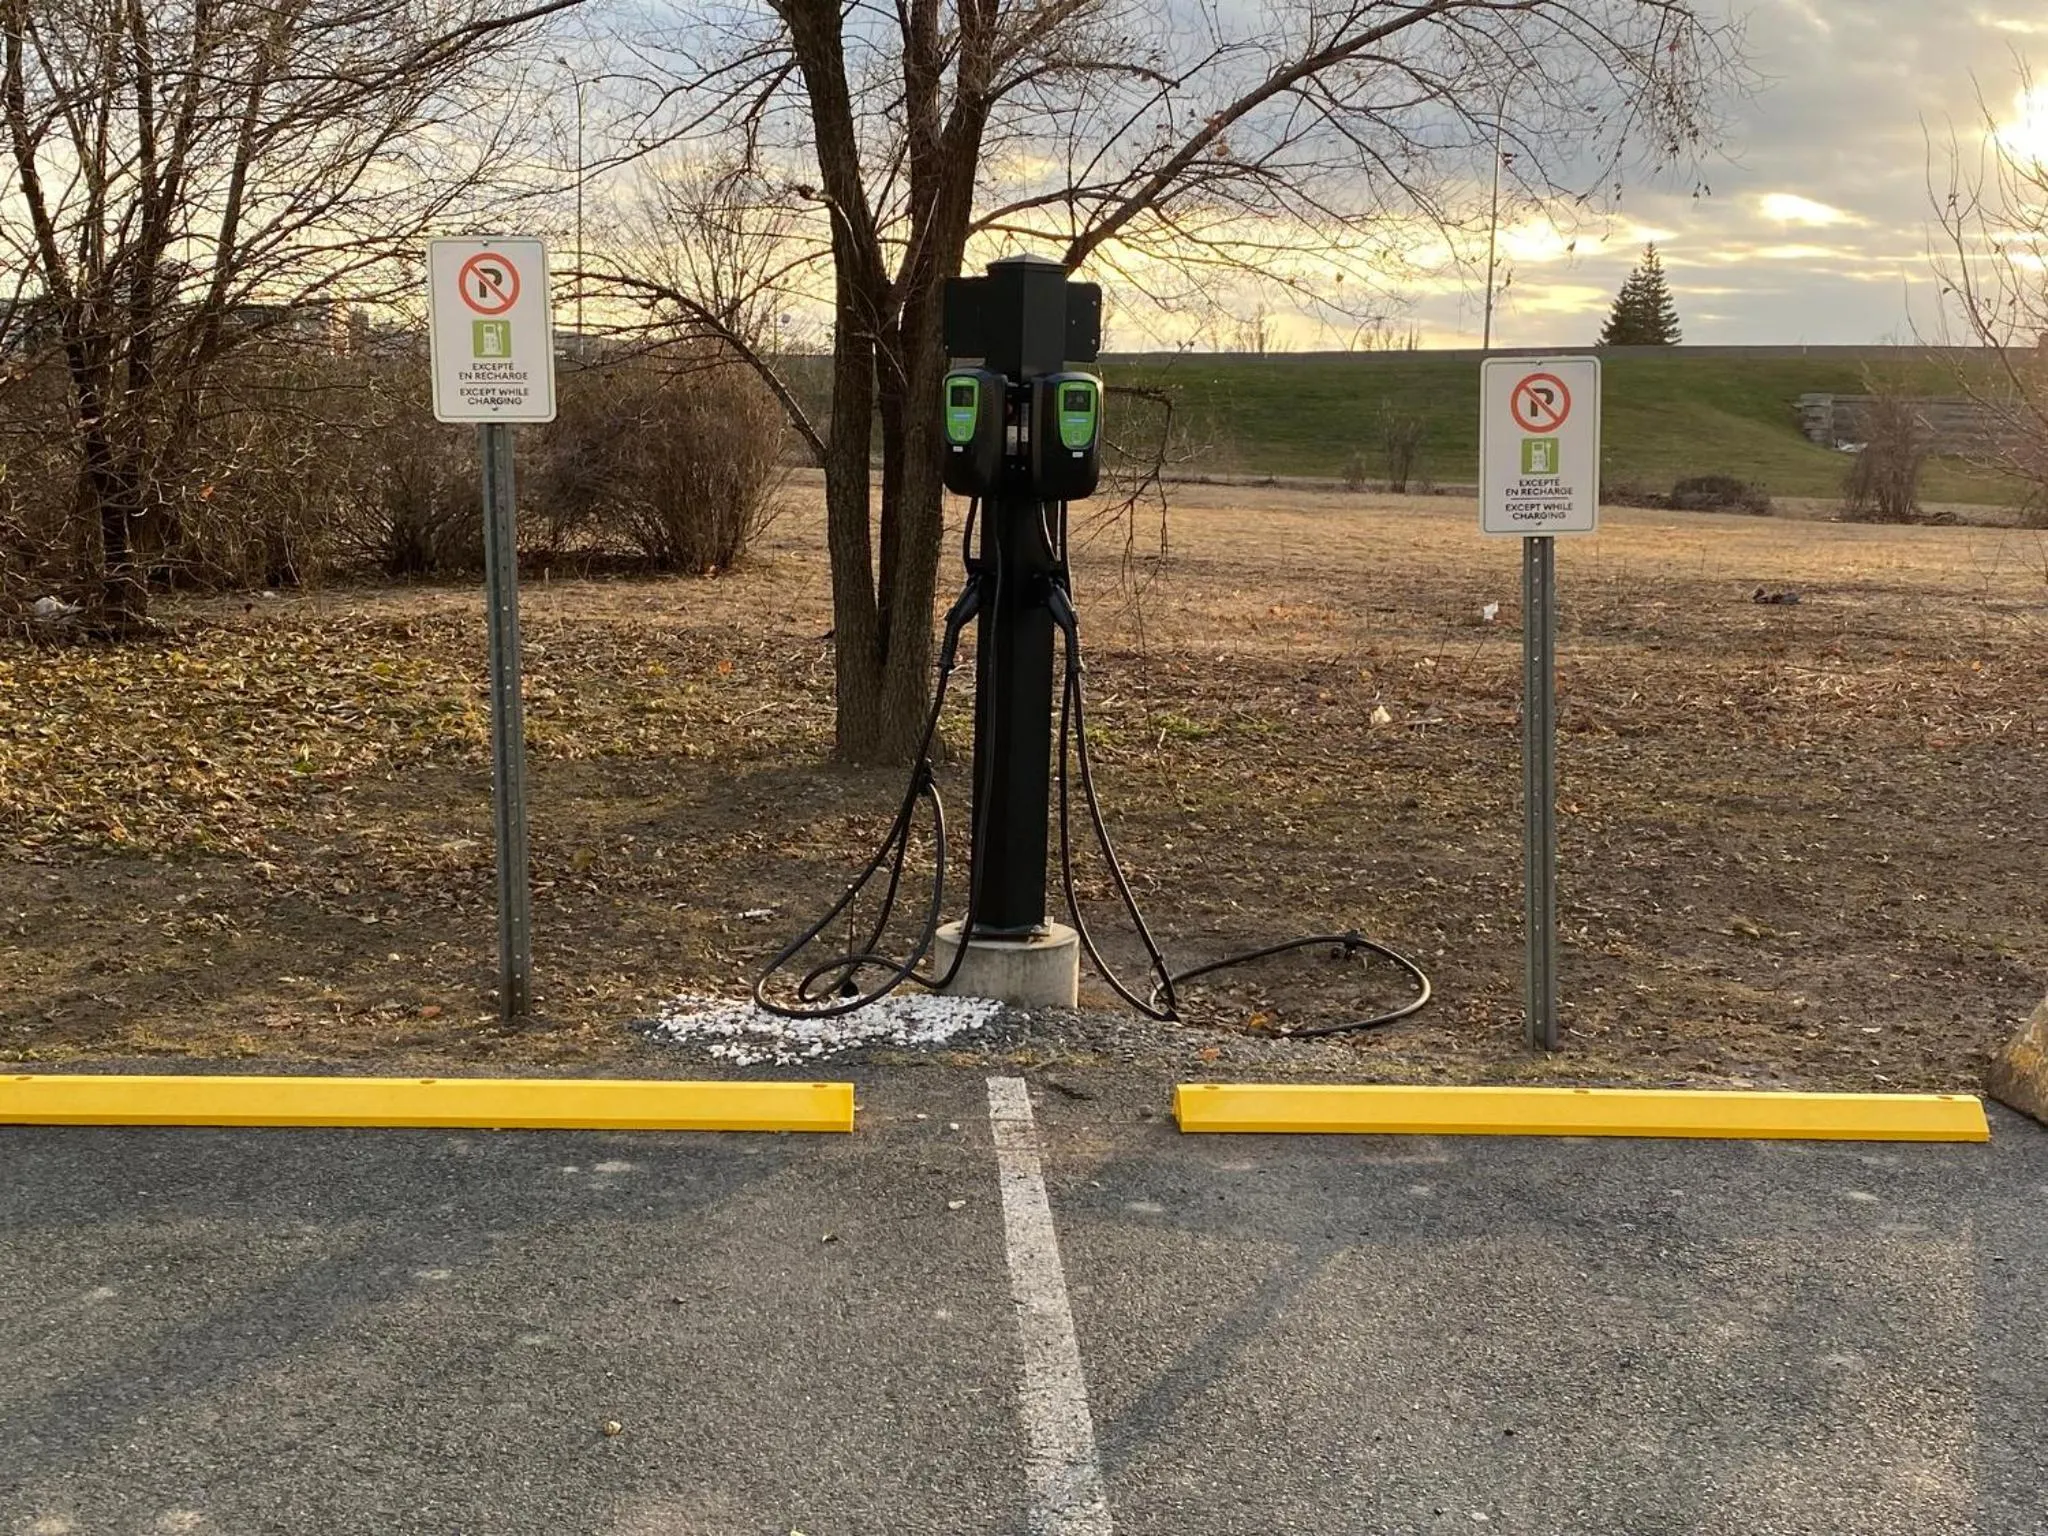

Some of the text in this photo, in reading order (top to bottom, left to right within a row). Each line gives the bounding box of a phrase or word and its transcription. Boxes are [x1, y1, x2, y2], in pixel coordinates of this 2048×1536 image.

[479, 268, 503, 298] P
[459, 372, 529, 381] EN RECHARGE
[460, 388, 529, 397] EXCEPT WHILE
[467, 397, 523, 405] CHARGING
[1530, 388, 1554, 417] P
[1505, 487, 1574, 497] EN RECHARGE
[1505, 502, 1574, 512] EXCEPT WHILE
[1512, 512, 1567, 520] CHARGING
